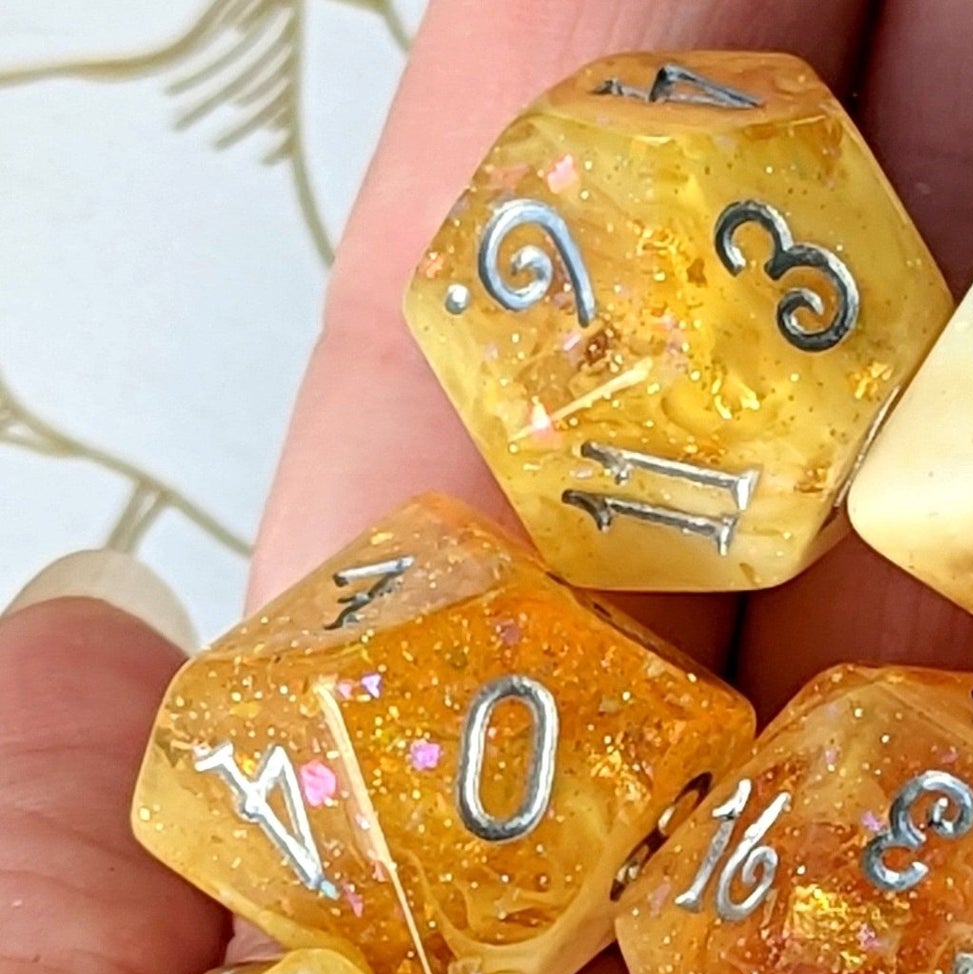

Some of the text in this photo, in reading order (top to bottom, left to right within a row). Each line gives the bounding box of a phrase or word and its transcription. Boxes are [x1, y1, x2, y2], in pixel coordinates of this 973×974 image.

[715, 201, 858, 351] 3
[562, 441, 759, 555] 11
[194, 743, 336, 897] 4
[458, 675, 558, 841] 0
[675, 778, 790, 920] 16
